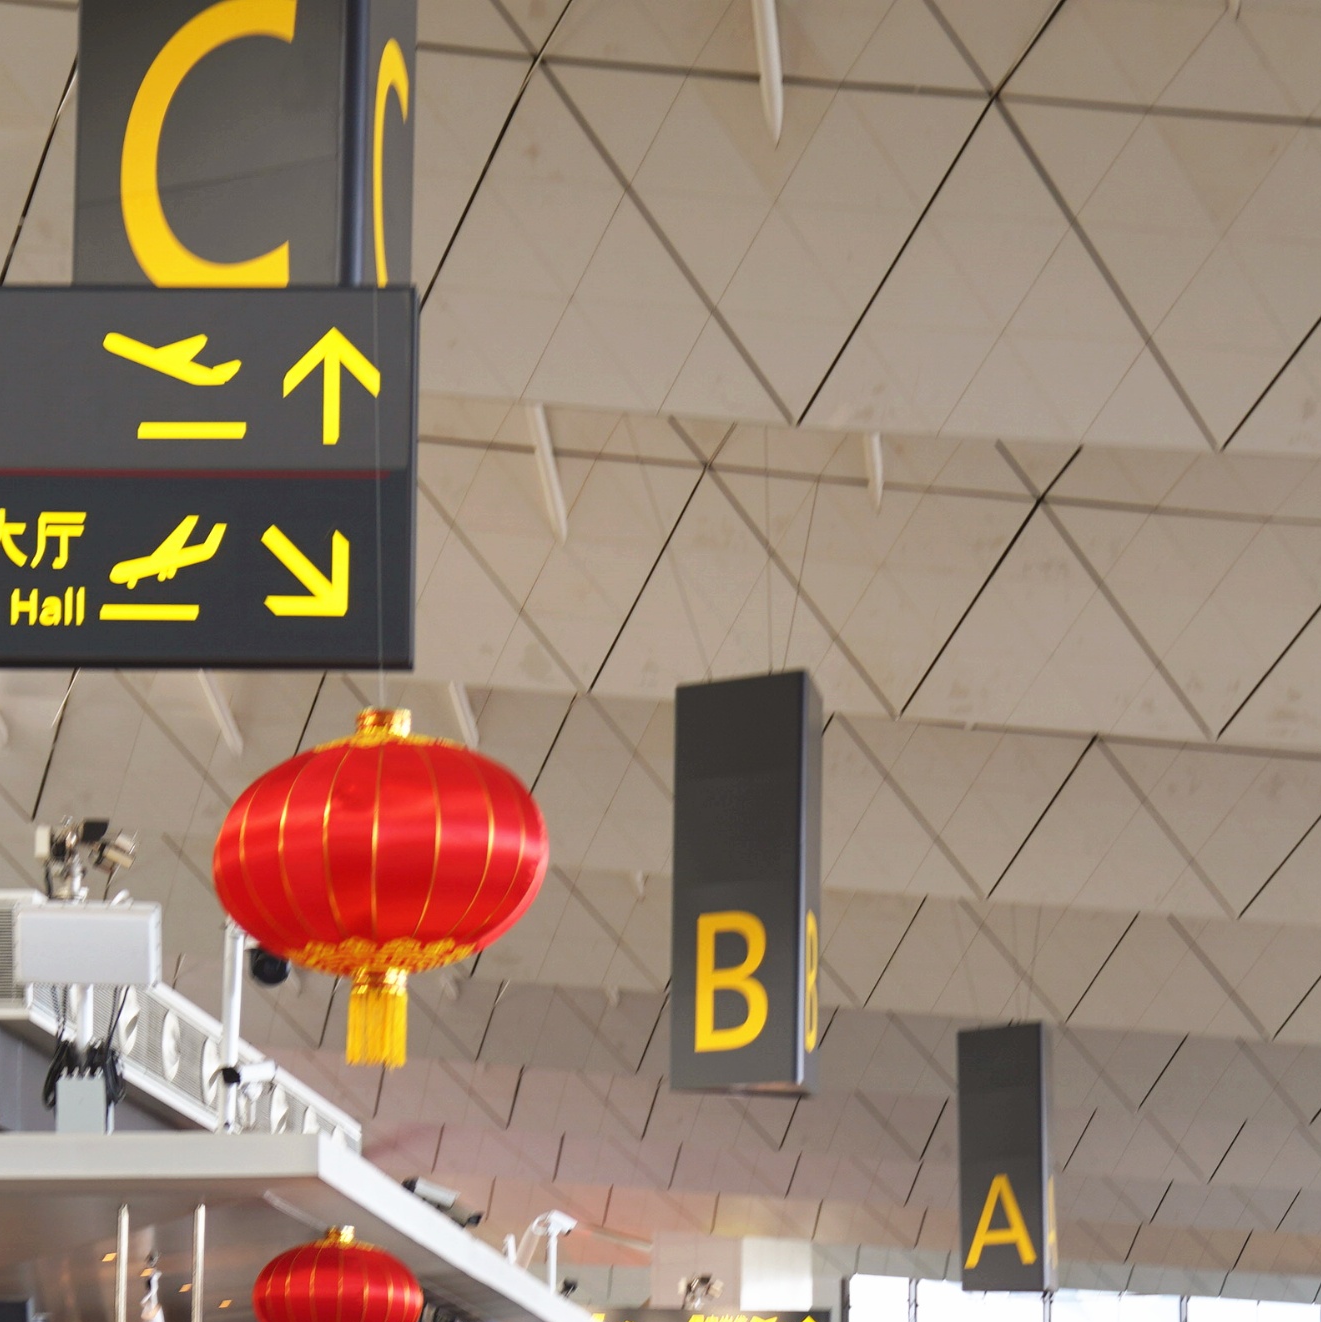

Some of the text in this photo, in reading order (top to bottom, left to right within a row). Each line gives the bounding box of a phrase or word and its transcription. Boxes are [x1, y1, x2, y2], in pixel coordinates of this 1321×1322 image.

[120, 0, 296, 287] C
[9, 586, 86, 627] Hall
[693, 911, 769, 1053] B
[964, 1173, 1036, 1269] A
